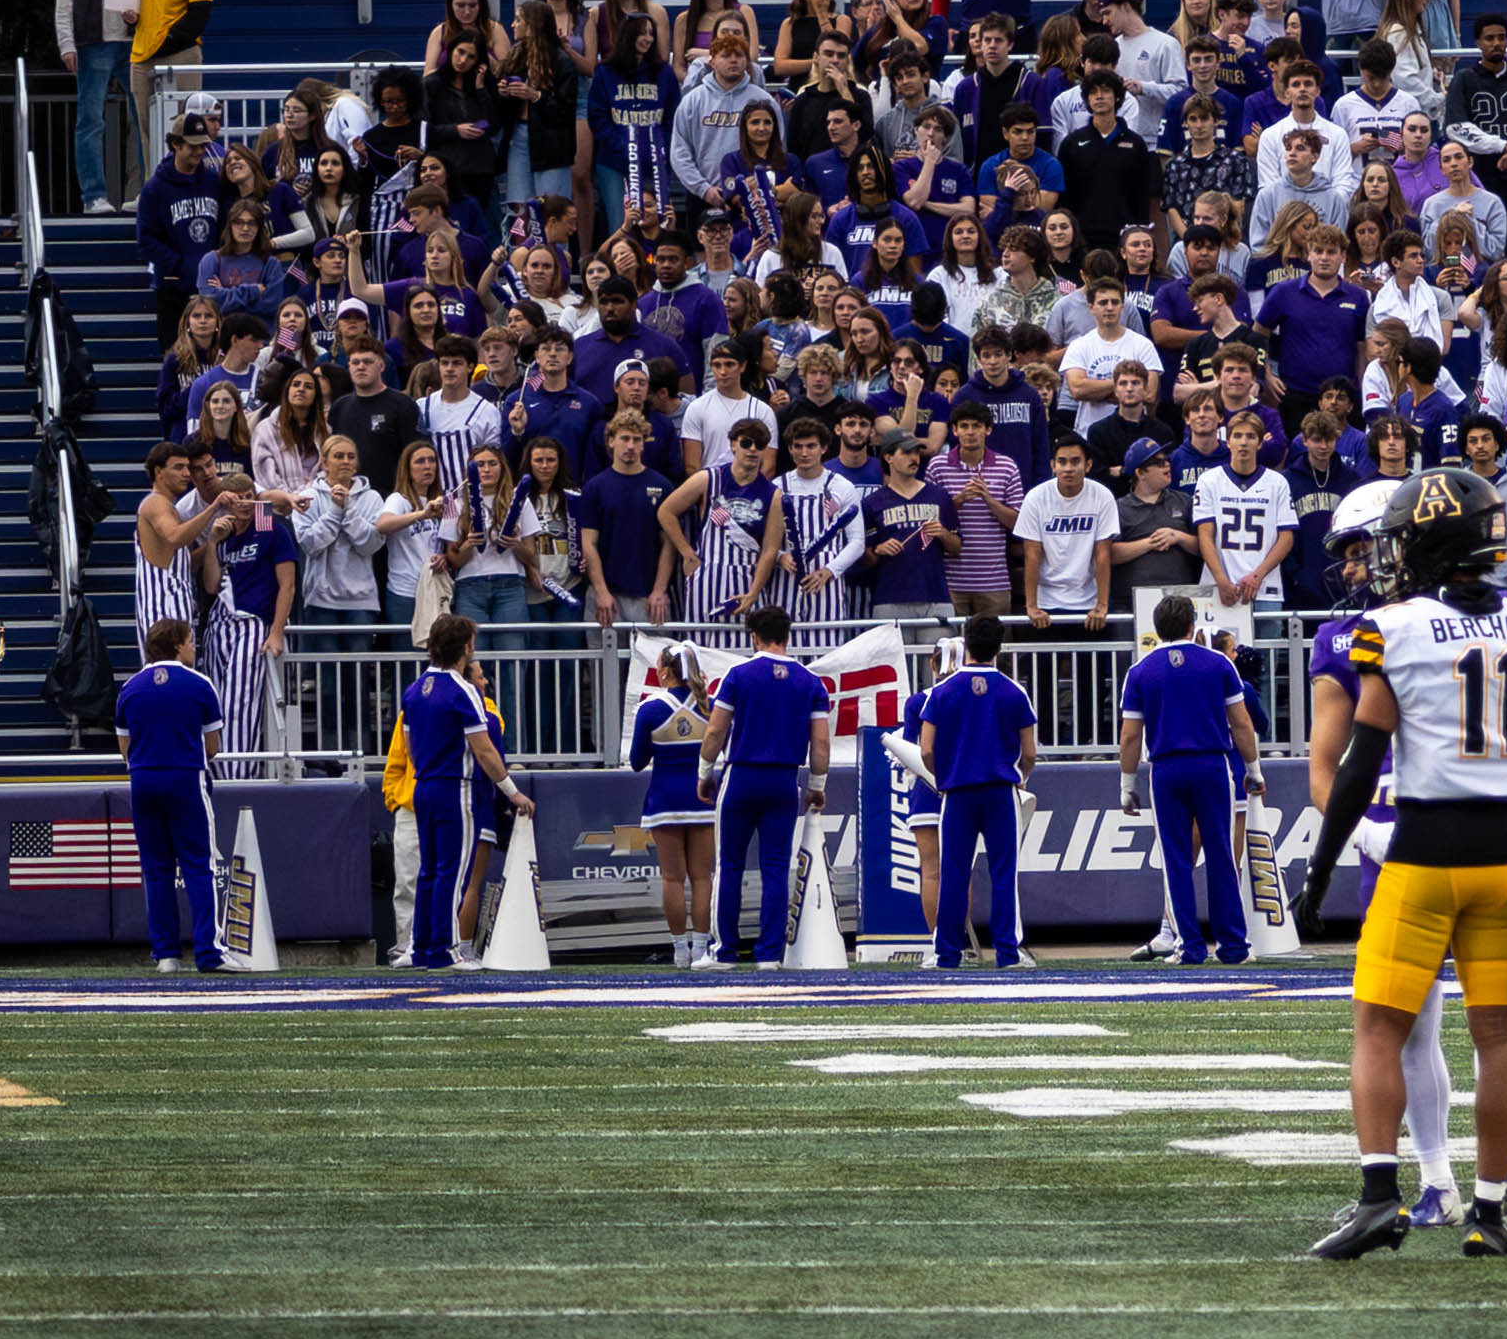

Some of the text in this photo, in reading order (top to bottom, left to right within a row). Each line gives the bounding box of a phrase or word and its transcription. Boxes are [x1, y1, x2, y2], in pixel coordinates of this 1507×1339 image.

[1443, 425, 1458, 443] 25
[1413, 473, 1463, 524] A
[1044, 514, 1094, 534] JMU
[1221, 507, 1264, 552] 25
[890, 765, 923, 894] DUKES
[572, 865, 664, 880] CHEVROL
[1246, 828, 1286, 928] JMU
[224, 855, 256, 957] JMU
